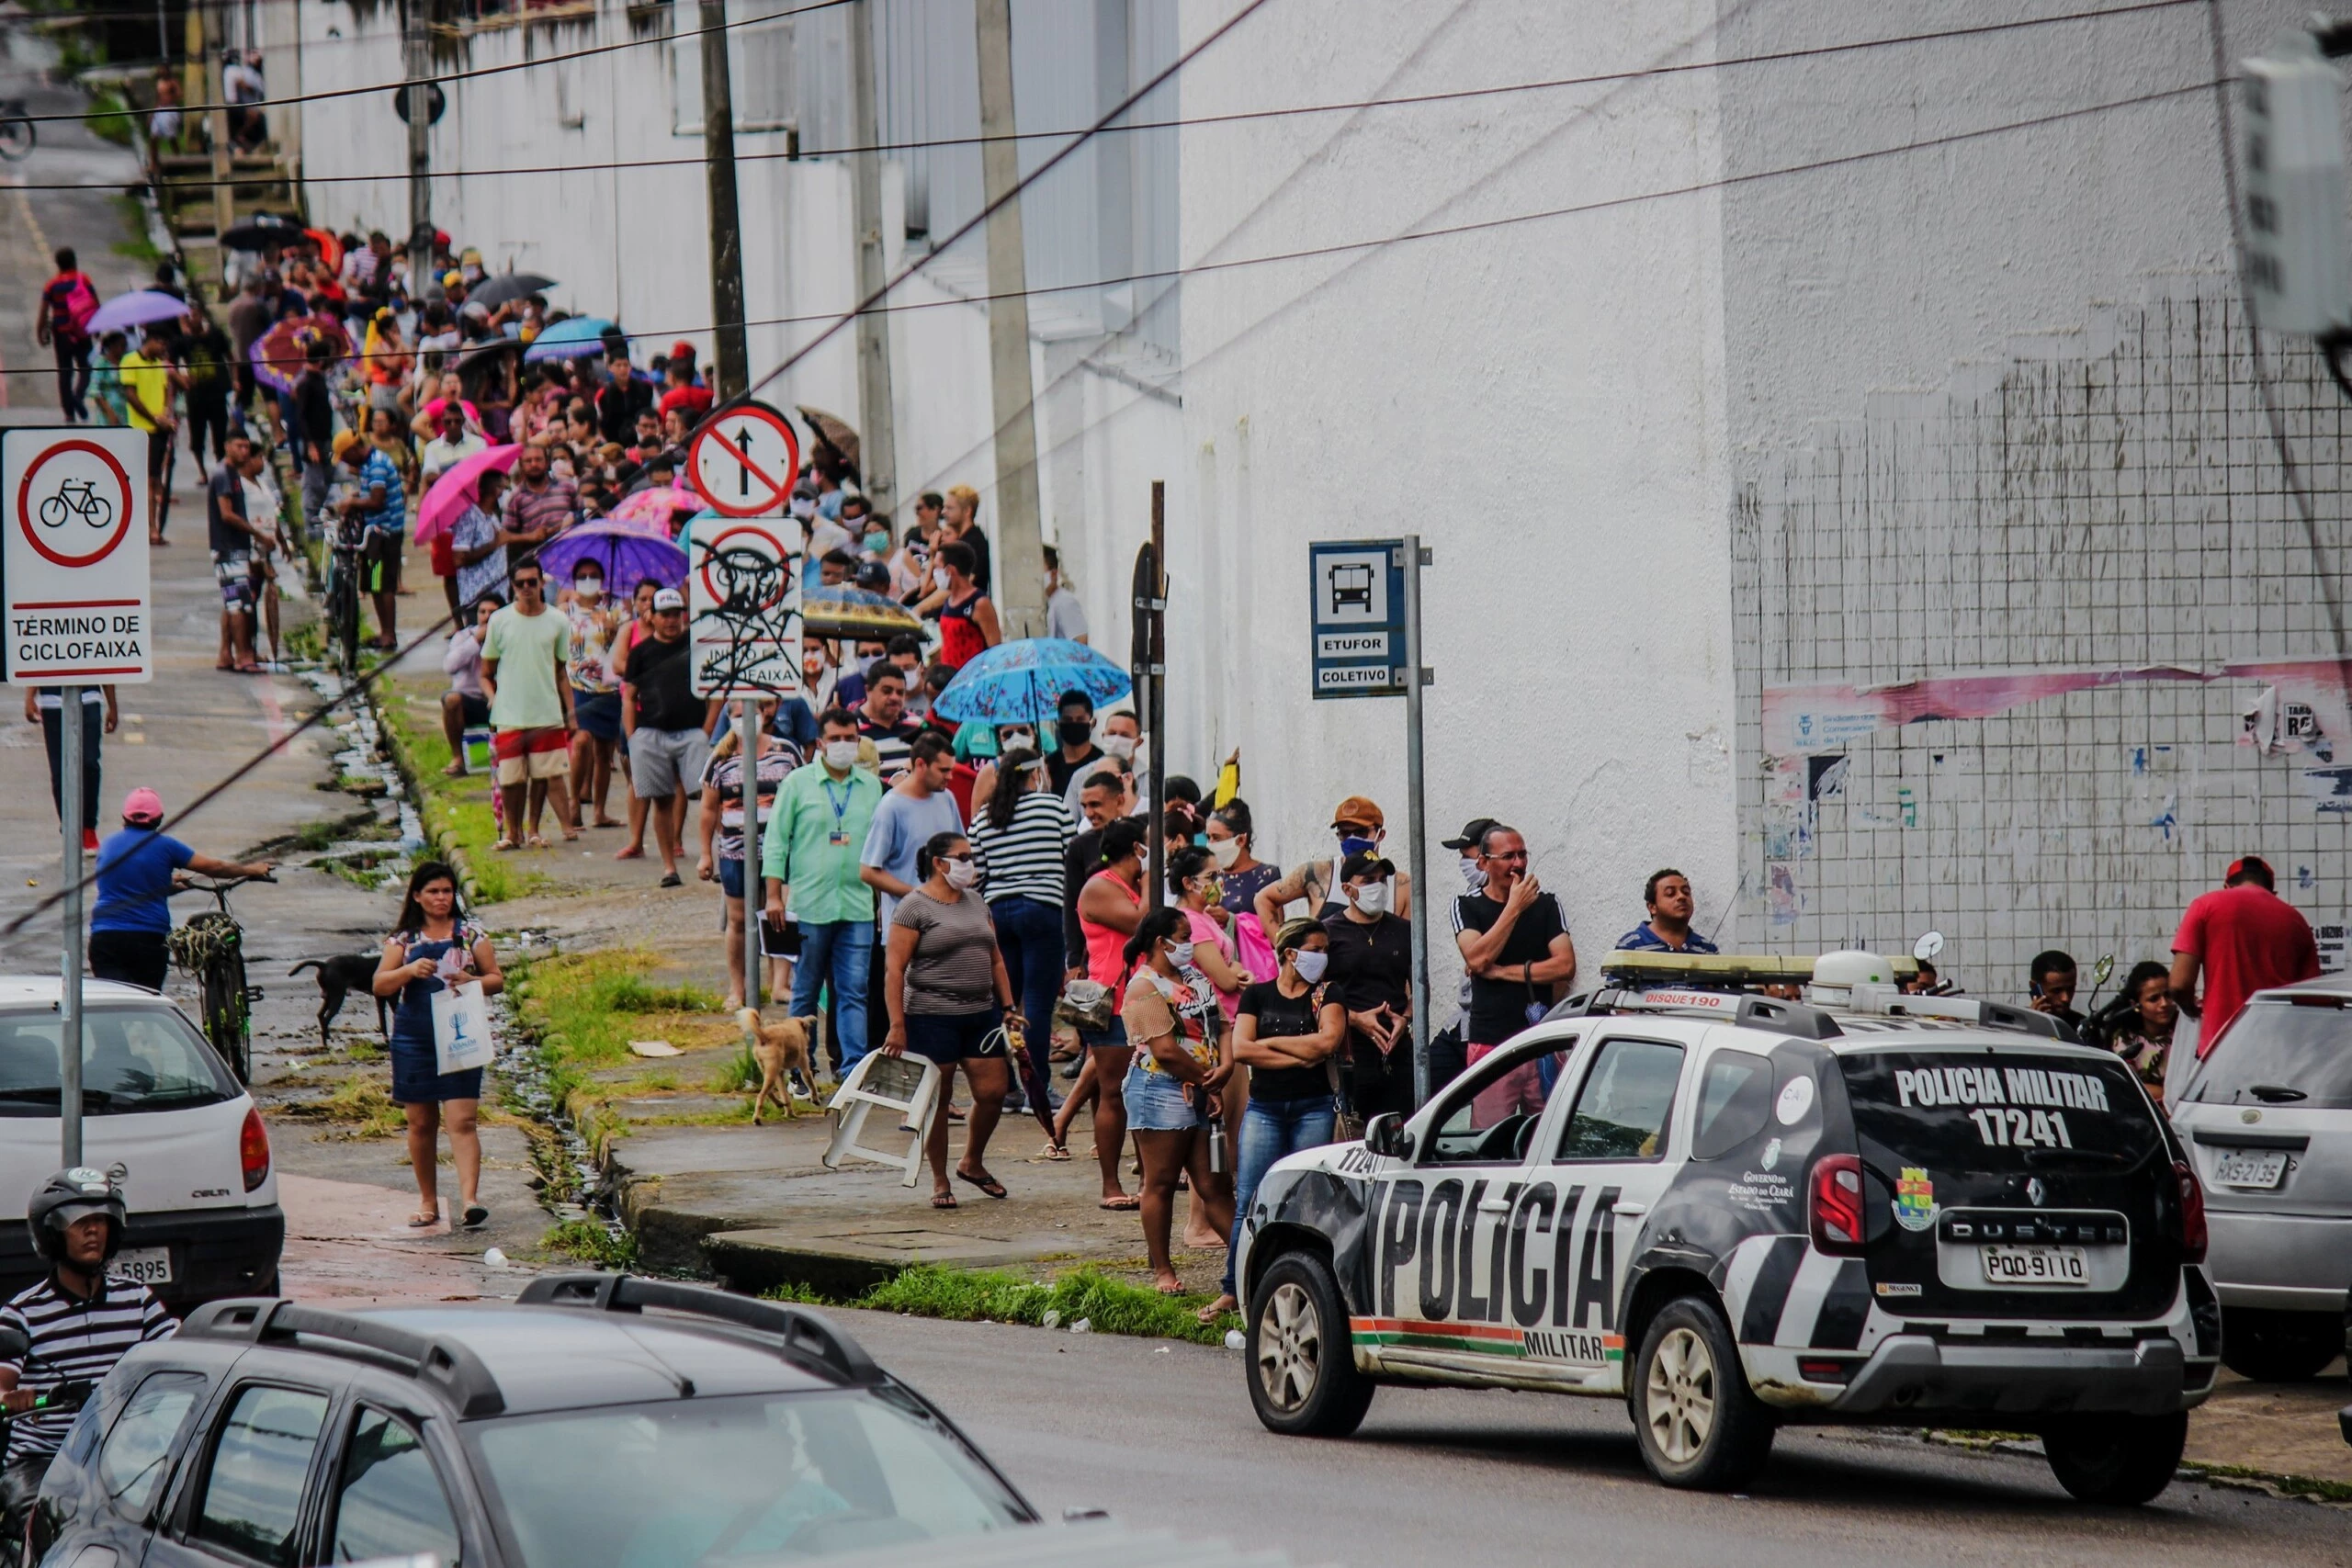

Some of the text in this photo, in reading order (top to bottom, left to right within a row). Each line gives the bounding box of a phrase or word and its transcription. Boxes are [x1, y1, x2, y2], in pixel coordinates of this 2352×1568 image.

[13, 615, 140, 636] TÉRMINO DE
[19, 640, 141, 660] CICLOFAIXA
[1324, 638, 1382, 650] ETUFOR
[1322, 670, 1385, 682] COLETIVO
[1645, 994, 1720, 1007] DISQUE 190
[2004, 1067, 2110, 1112] MILITAR
[1968, 1108, 2073, 1149] 17241
[1952, 1224, 2123, 1239] DUSTER
[1523, 1331, 1604, 1360] MILITAR
